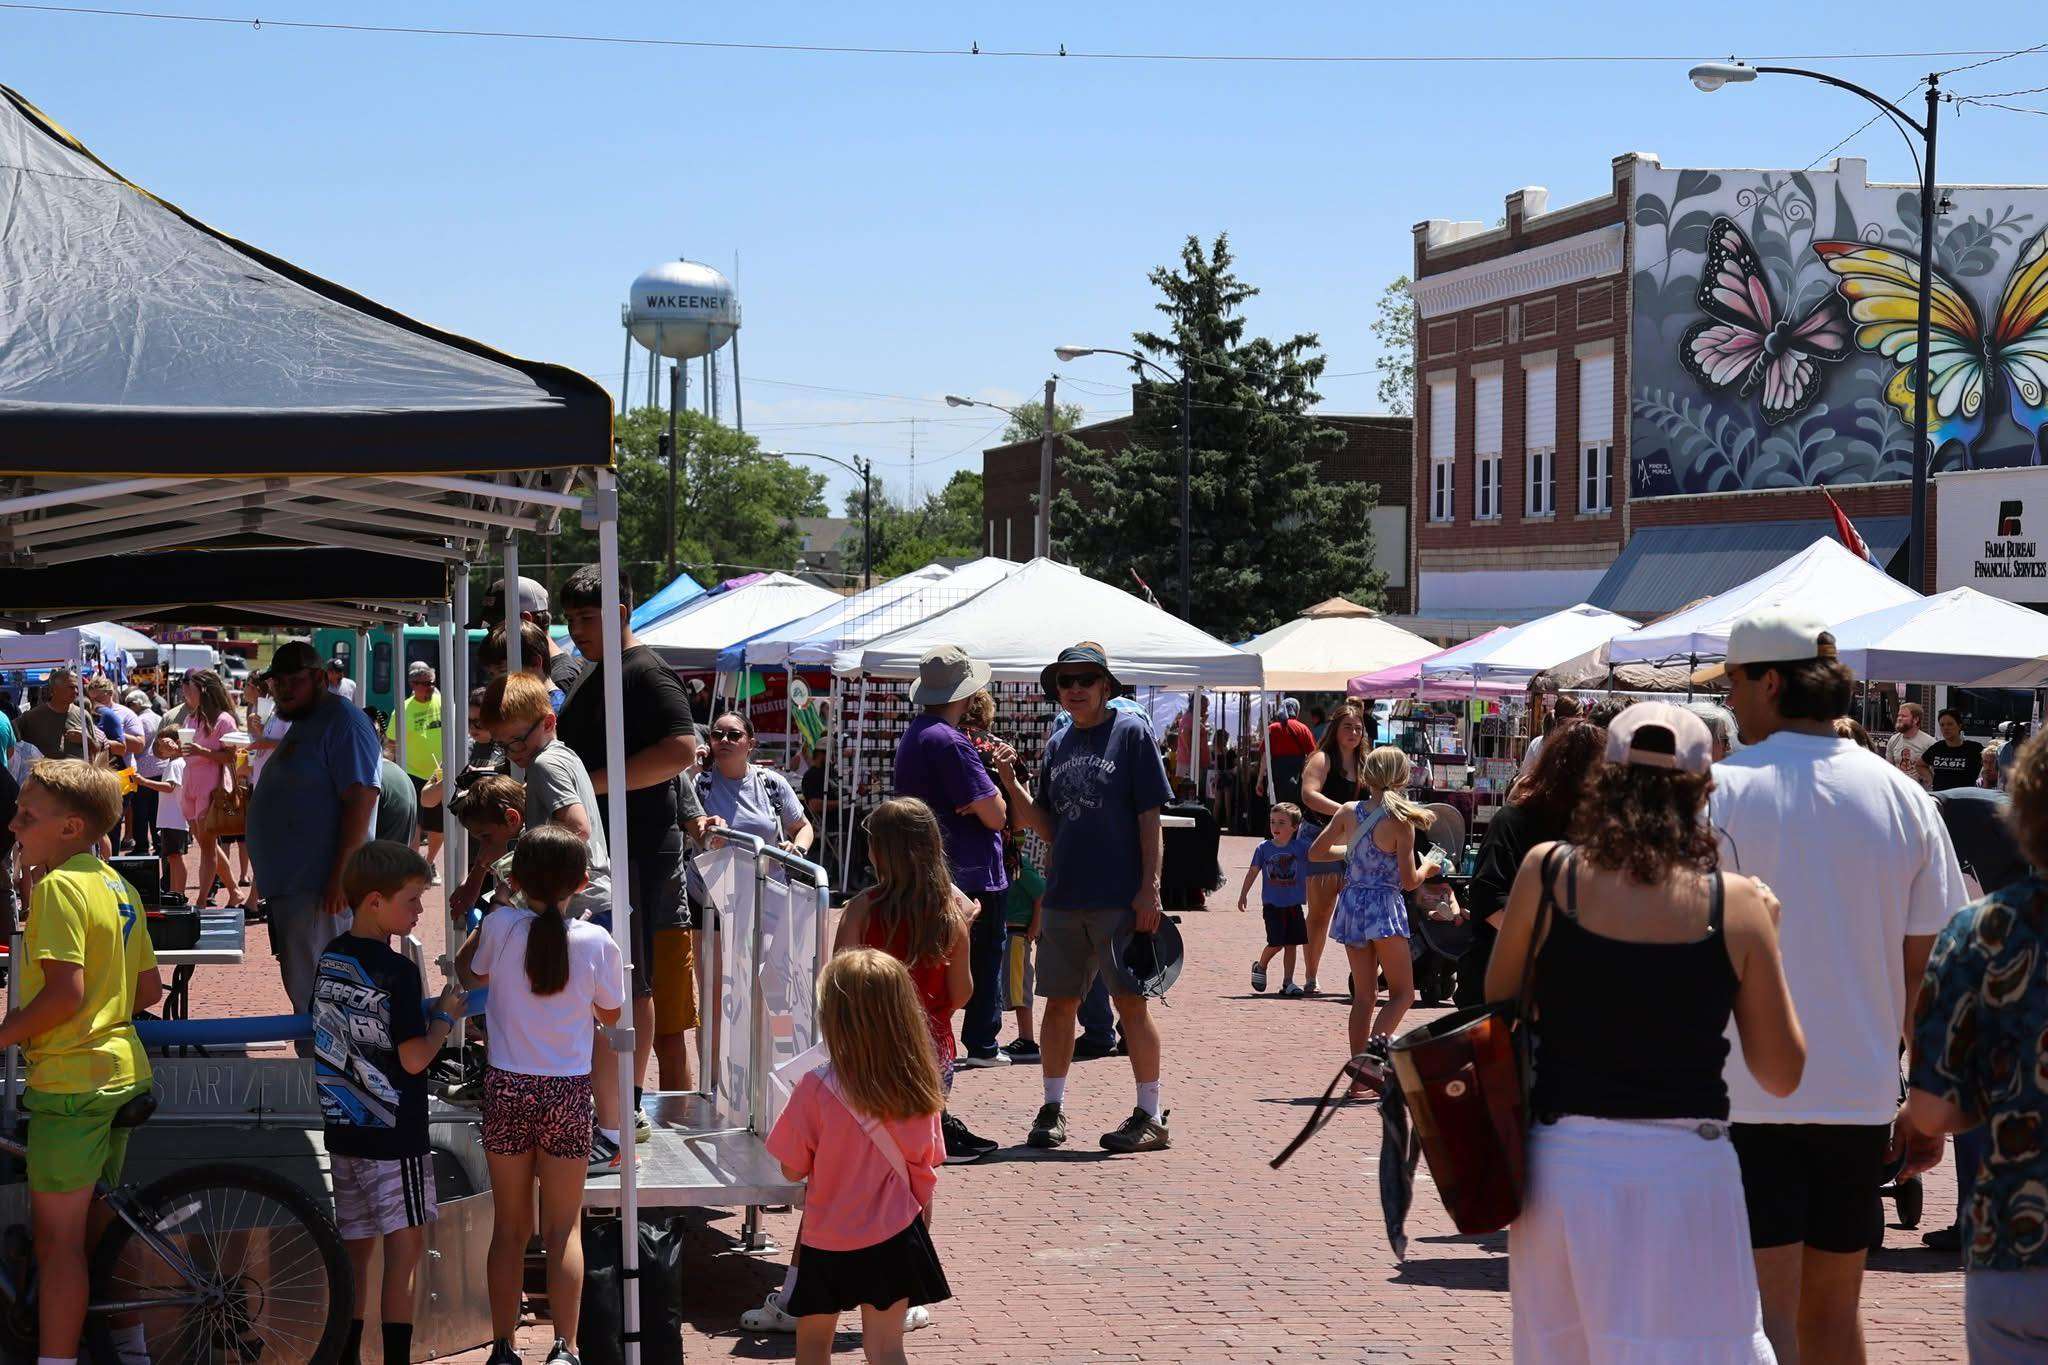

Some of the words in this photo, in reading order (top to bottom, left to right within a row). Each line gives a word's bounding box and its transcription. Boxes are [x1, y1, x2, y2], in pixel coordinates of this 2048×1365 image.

[646, 295, 726, 309] WAKEENEY
[1984, 541, 2006, 558] FARM
[2007, 541, 2036, 558] BUREAU
[1974, 561, 2012, 578] FINANCIAL
[2013, 561, 2047, 578] SERVICES
[751, 699, 787, 715] THEATE
[1933, 759, 1966, 768] DASH
[117, 903, 137, 948] 7
